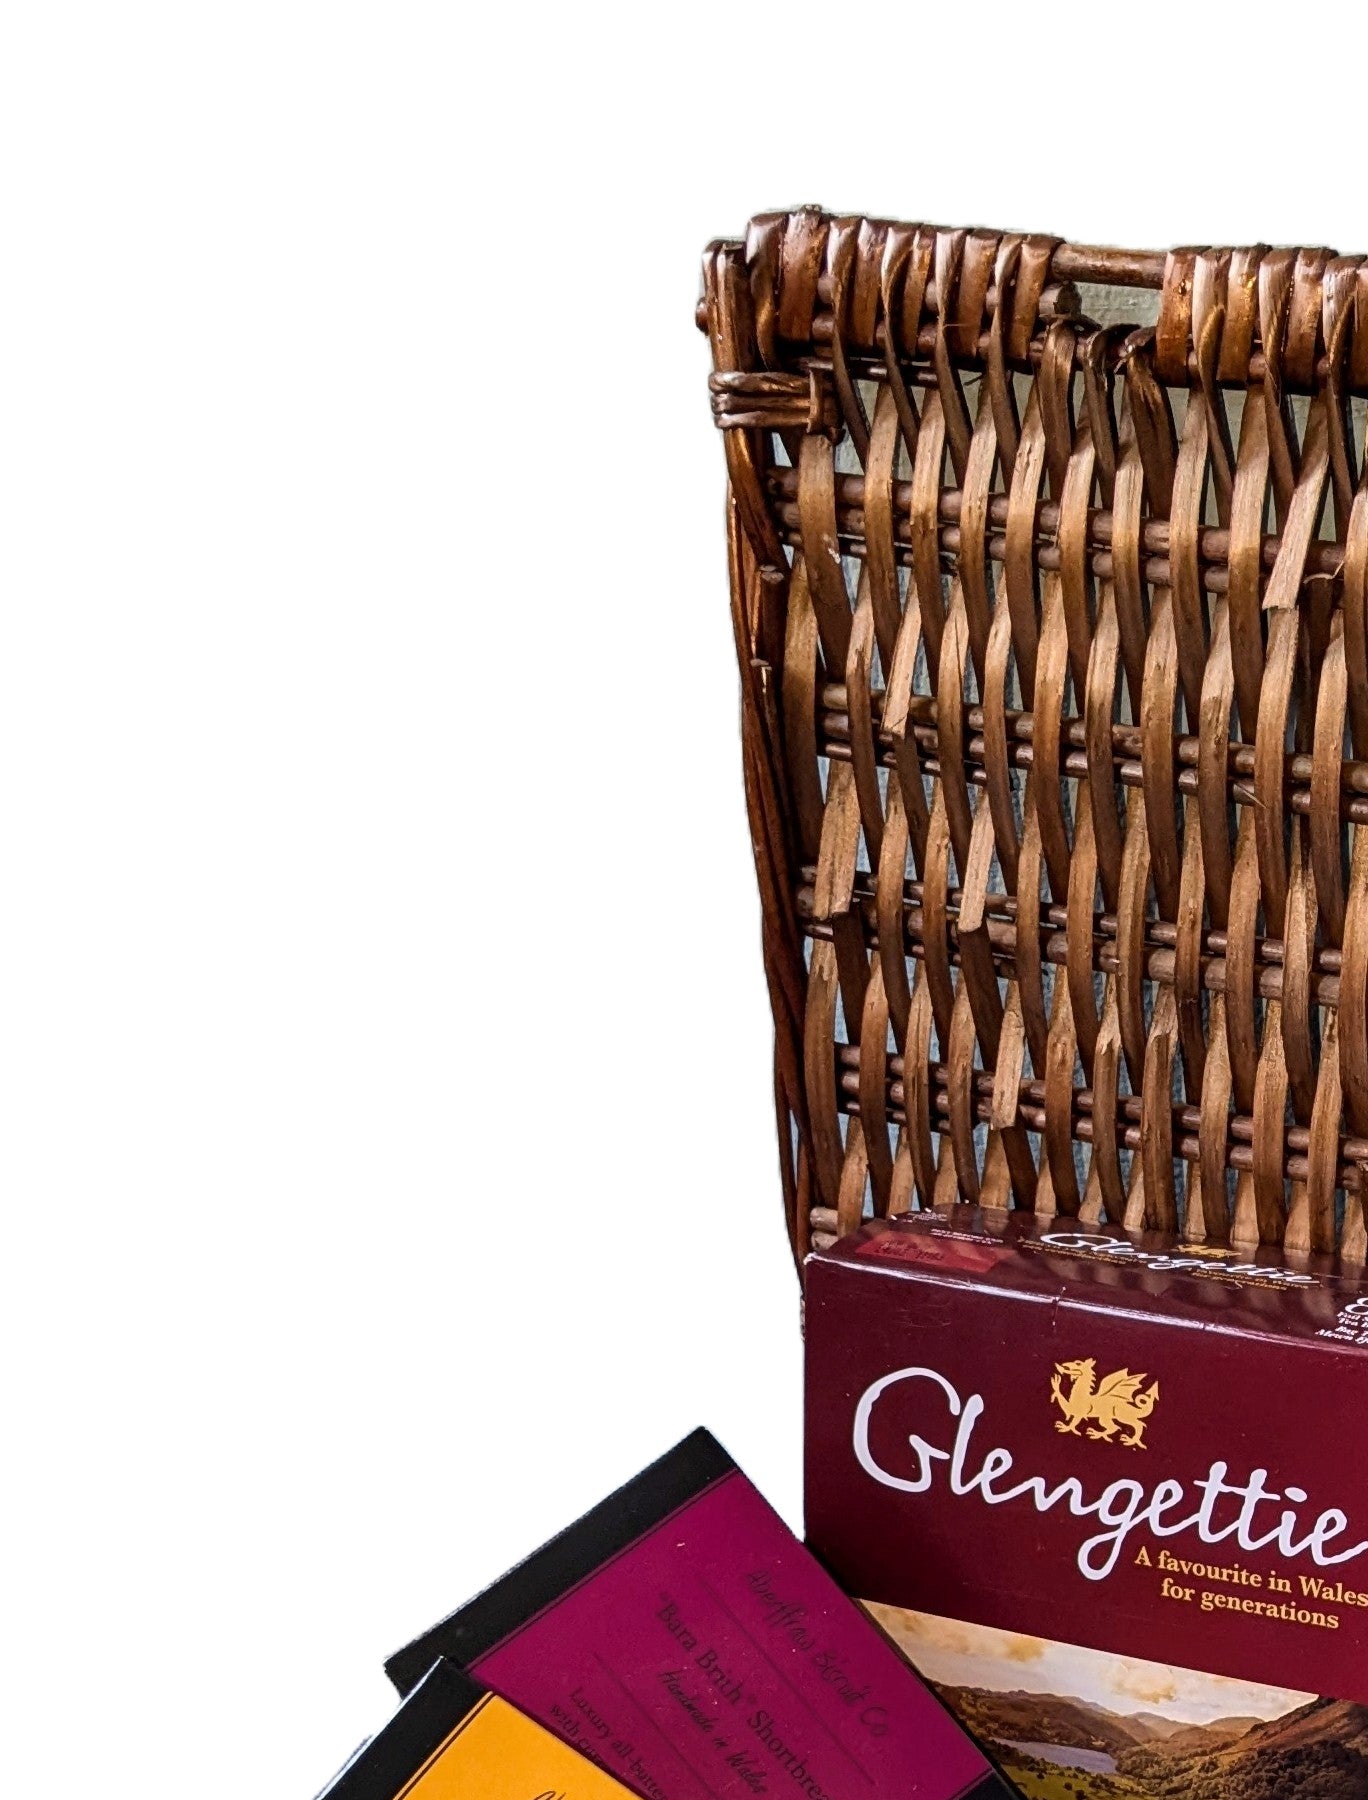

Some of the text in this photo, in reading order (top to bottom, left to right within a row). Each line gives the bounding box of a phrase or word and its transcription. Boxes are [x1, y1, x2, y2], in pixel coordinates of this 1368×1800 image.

[1039, 1233, 1320, 1284] Glengettie
[1134, 1546, 1152, 1567] A
[1157, 1550, 1263, 1587] favourite
[1268, 1570, 1293, 1593] in
[1160, 1578, 1339, 1629] for generations
[860, 1706, 888, 1736] Co
